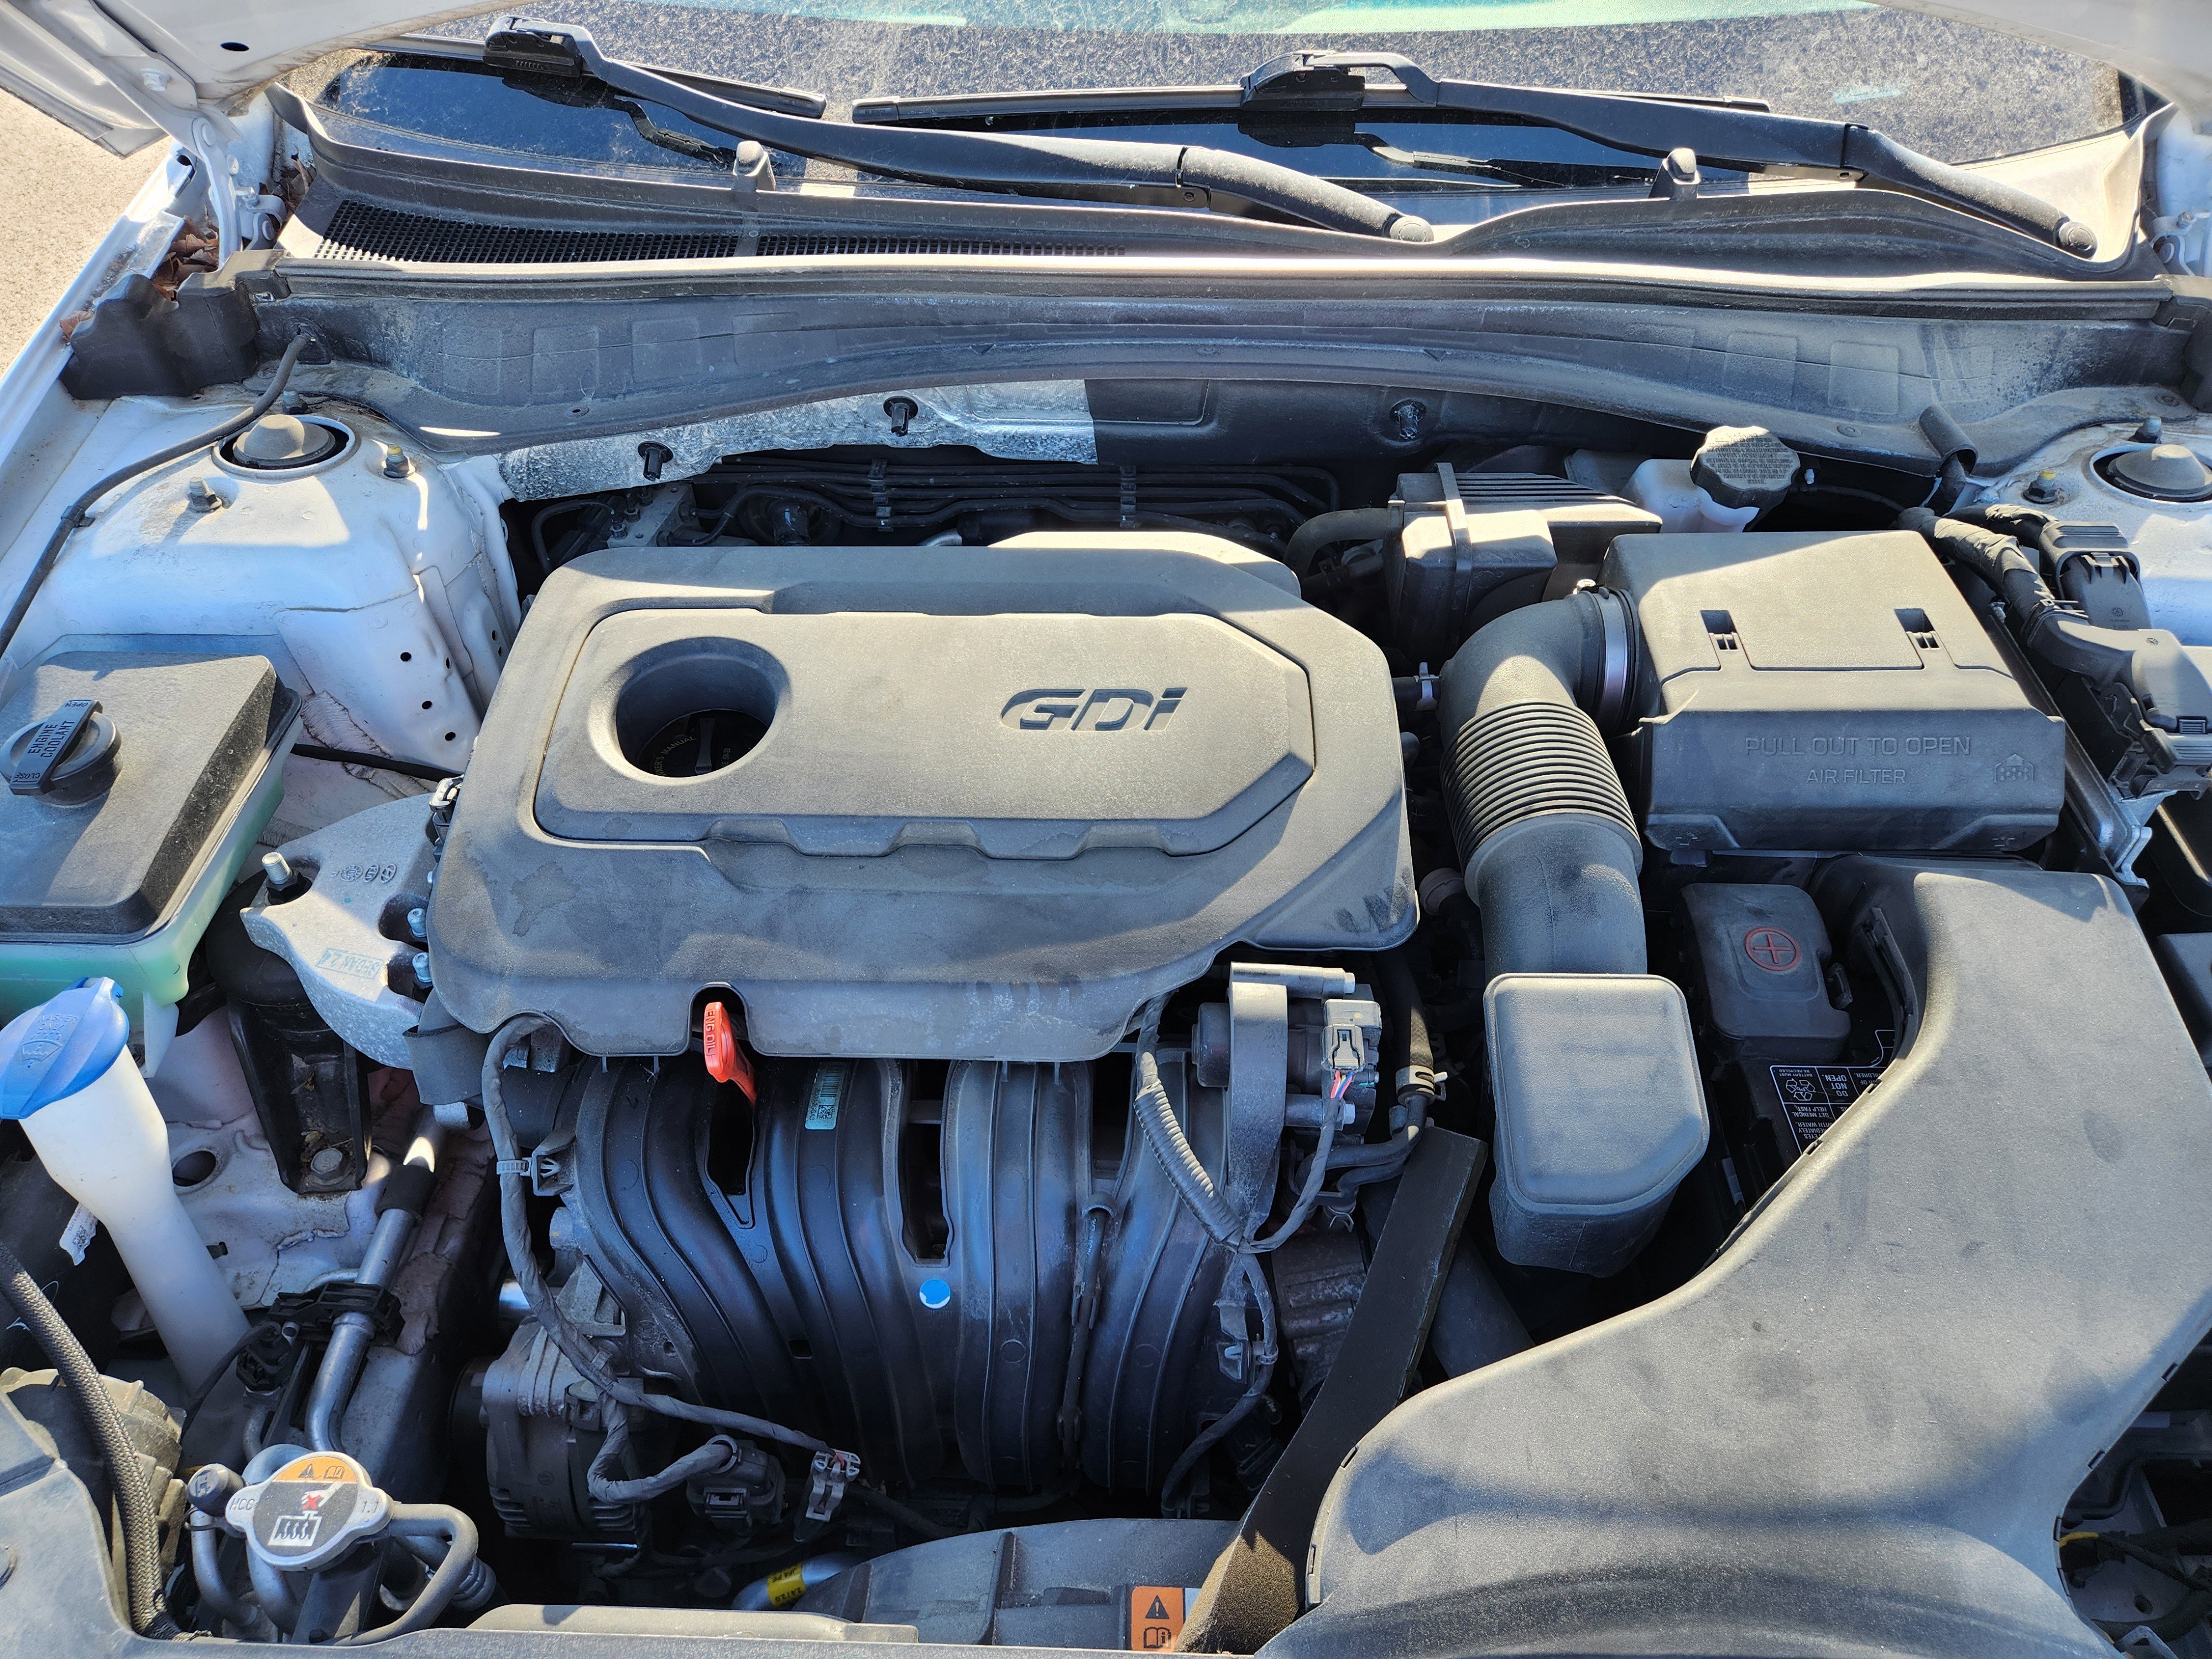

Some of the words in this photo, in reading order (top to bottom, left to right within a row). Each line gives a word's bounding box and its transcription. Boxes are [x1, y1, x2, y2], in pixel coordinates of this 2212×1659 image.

[1000, 687, 1188, 731] GDi
[27, 724, 58, 754] ENGINE
[40, 720, 75, 758] COOLANT
[660, 735, 697, 755] MANUAL
[1745, 737, 1805, 756] PULL
[1811, 737, 1860, 756] OUT
[1867, 737, 1898, 756] TO
[1905, 737, 1971, 755] OPEN
[1806, 769, 1838, 784] AIR
[1843, 769, 1906, 784] FILTER
[38, 1014, 80, 1024] WASHER
[705, 1008, 716, 1032] ENG
[706, 1034, 716, 1056] OIL
